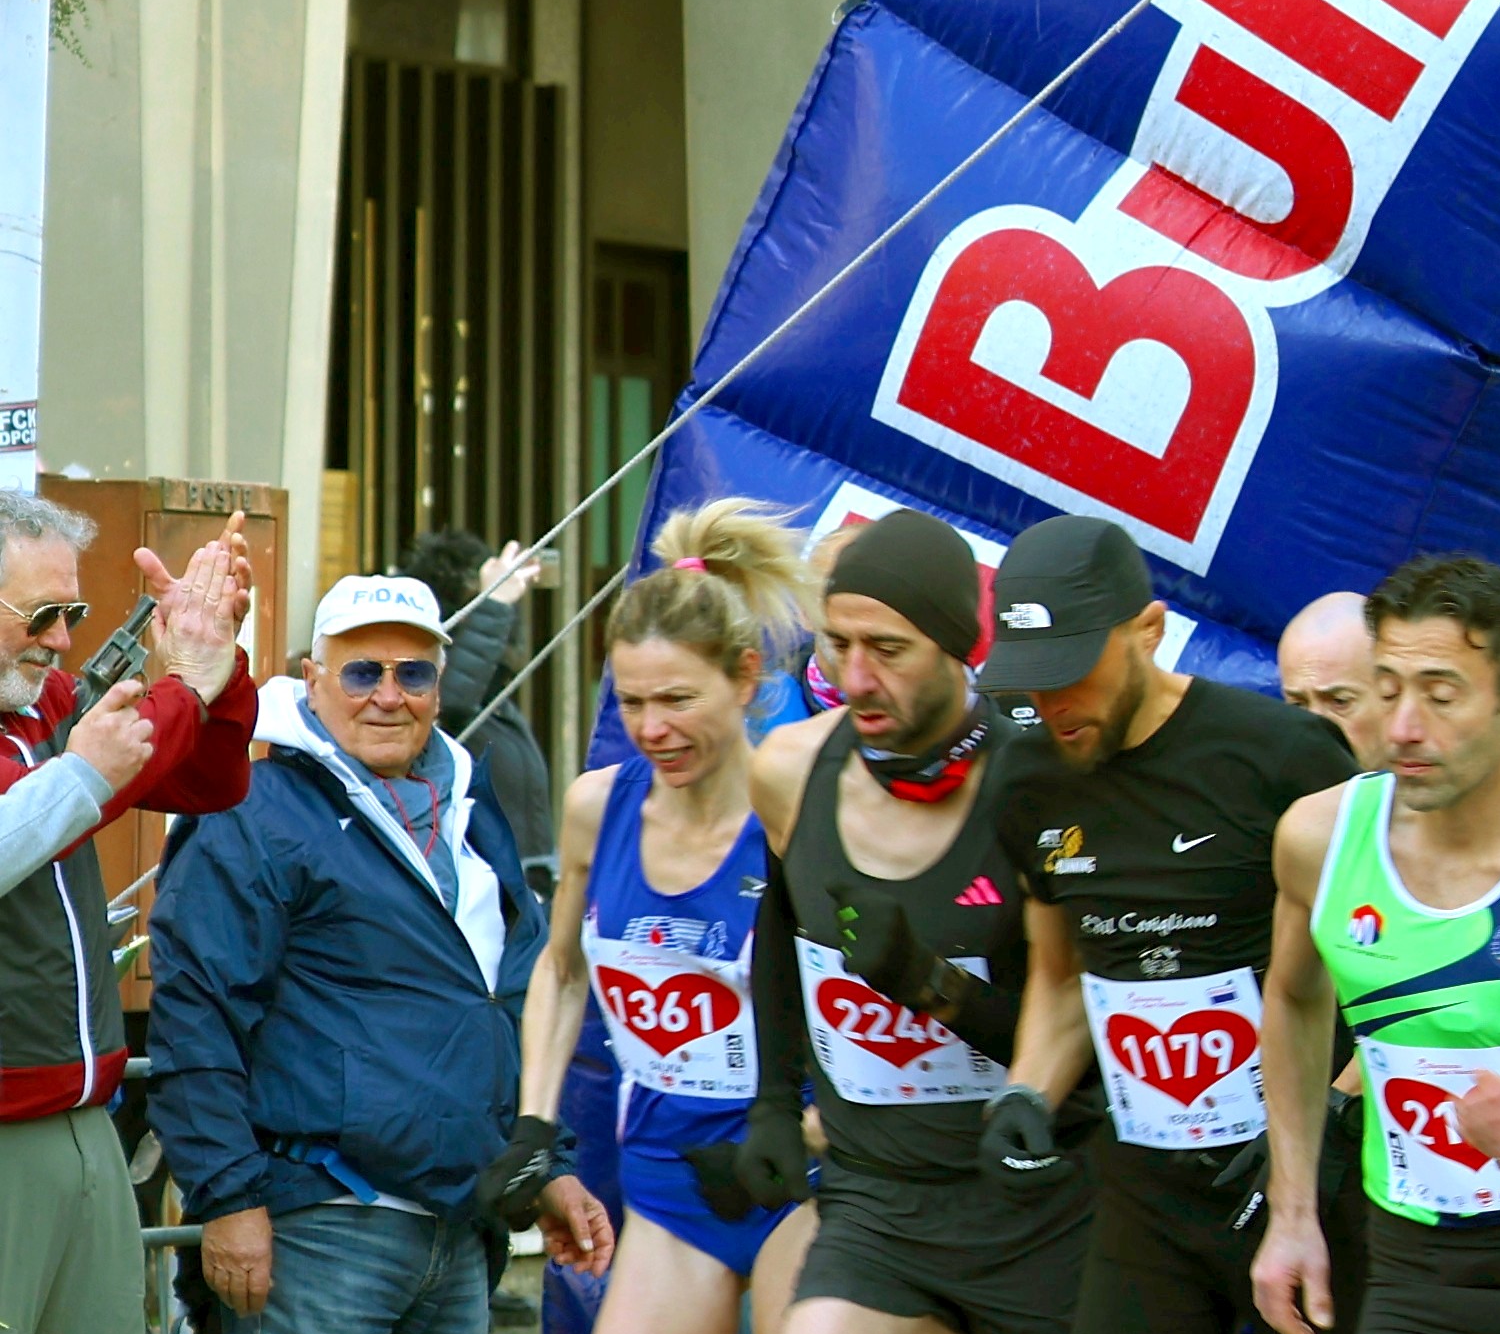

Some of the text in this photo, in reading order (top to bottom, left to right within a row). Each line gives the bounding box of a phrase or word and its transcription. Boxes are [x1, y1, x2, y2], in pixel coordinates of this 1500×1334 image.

[186, 483, 252, 511] POSTE
[352, 590, 426, 612] FIDAL
[607, 985, 715, 1035] 1361
[1121, 1028, 1235, 1080] 1179
